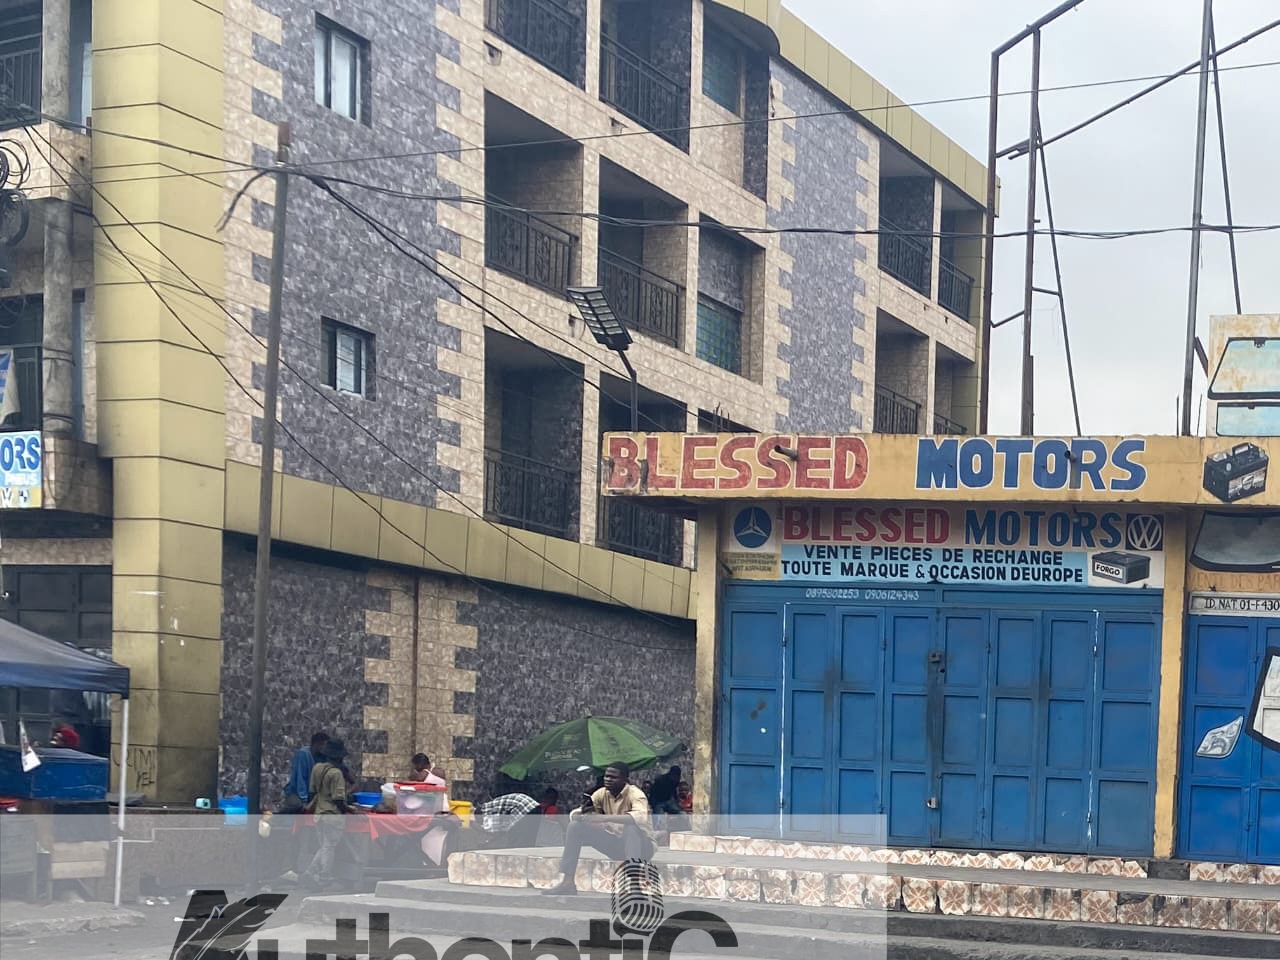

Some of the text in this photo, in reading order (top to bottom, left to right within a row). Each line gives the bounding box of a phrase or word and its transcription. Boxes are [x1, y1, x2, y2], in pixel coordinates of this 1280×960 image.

[607, 435, 1147, 492] BLESSED MOTORS
[783, 505, 1123, 548] BLESSED MOTORS
[803, 544, 1063, 566] VENTE PIECES DE RECHANGE
[781, 560, 832, 576] TOUTE
[840, 562, 909, 578] MARQUE
[915, 564, 925, 578] &
[928, 564, 1006, 581] OCCASION
[1096, 564, 1121, 576] FORGO
